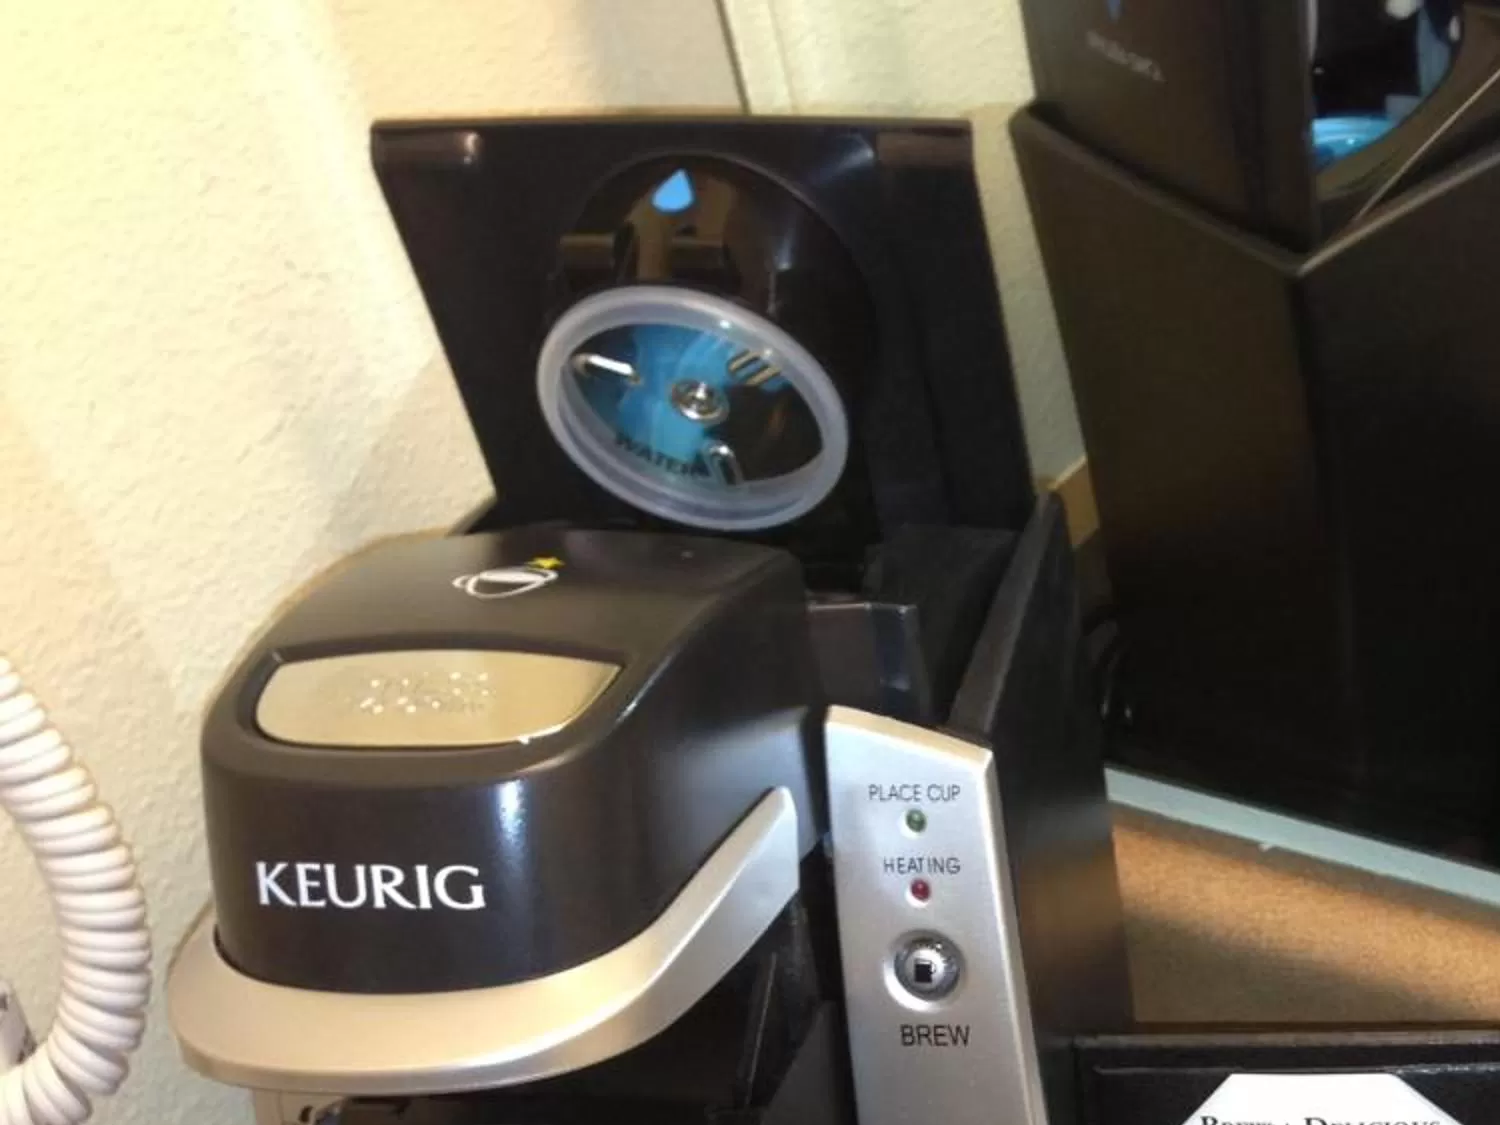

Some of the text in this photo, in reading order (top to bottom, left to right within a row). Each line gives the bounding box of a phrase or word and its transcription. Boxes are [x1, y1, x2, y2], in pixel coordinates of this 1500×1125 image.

[868, 784, 961, 801] PLACE CUP
[883, 857, 961, 875] HEATING
[255, 860, 487, 910] KEURIG
[900, 1024, 970, 1047] BREW
